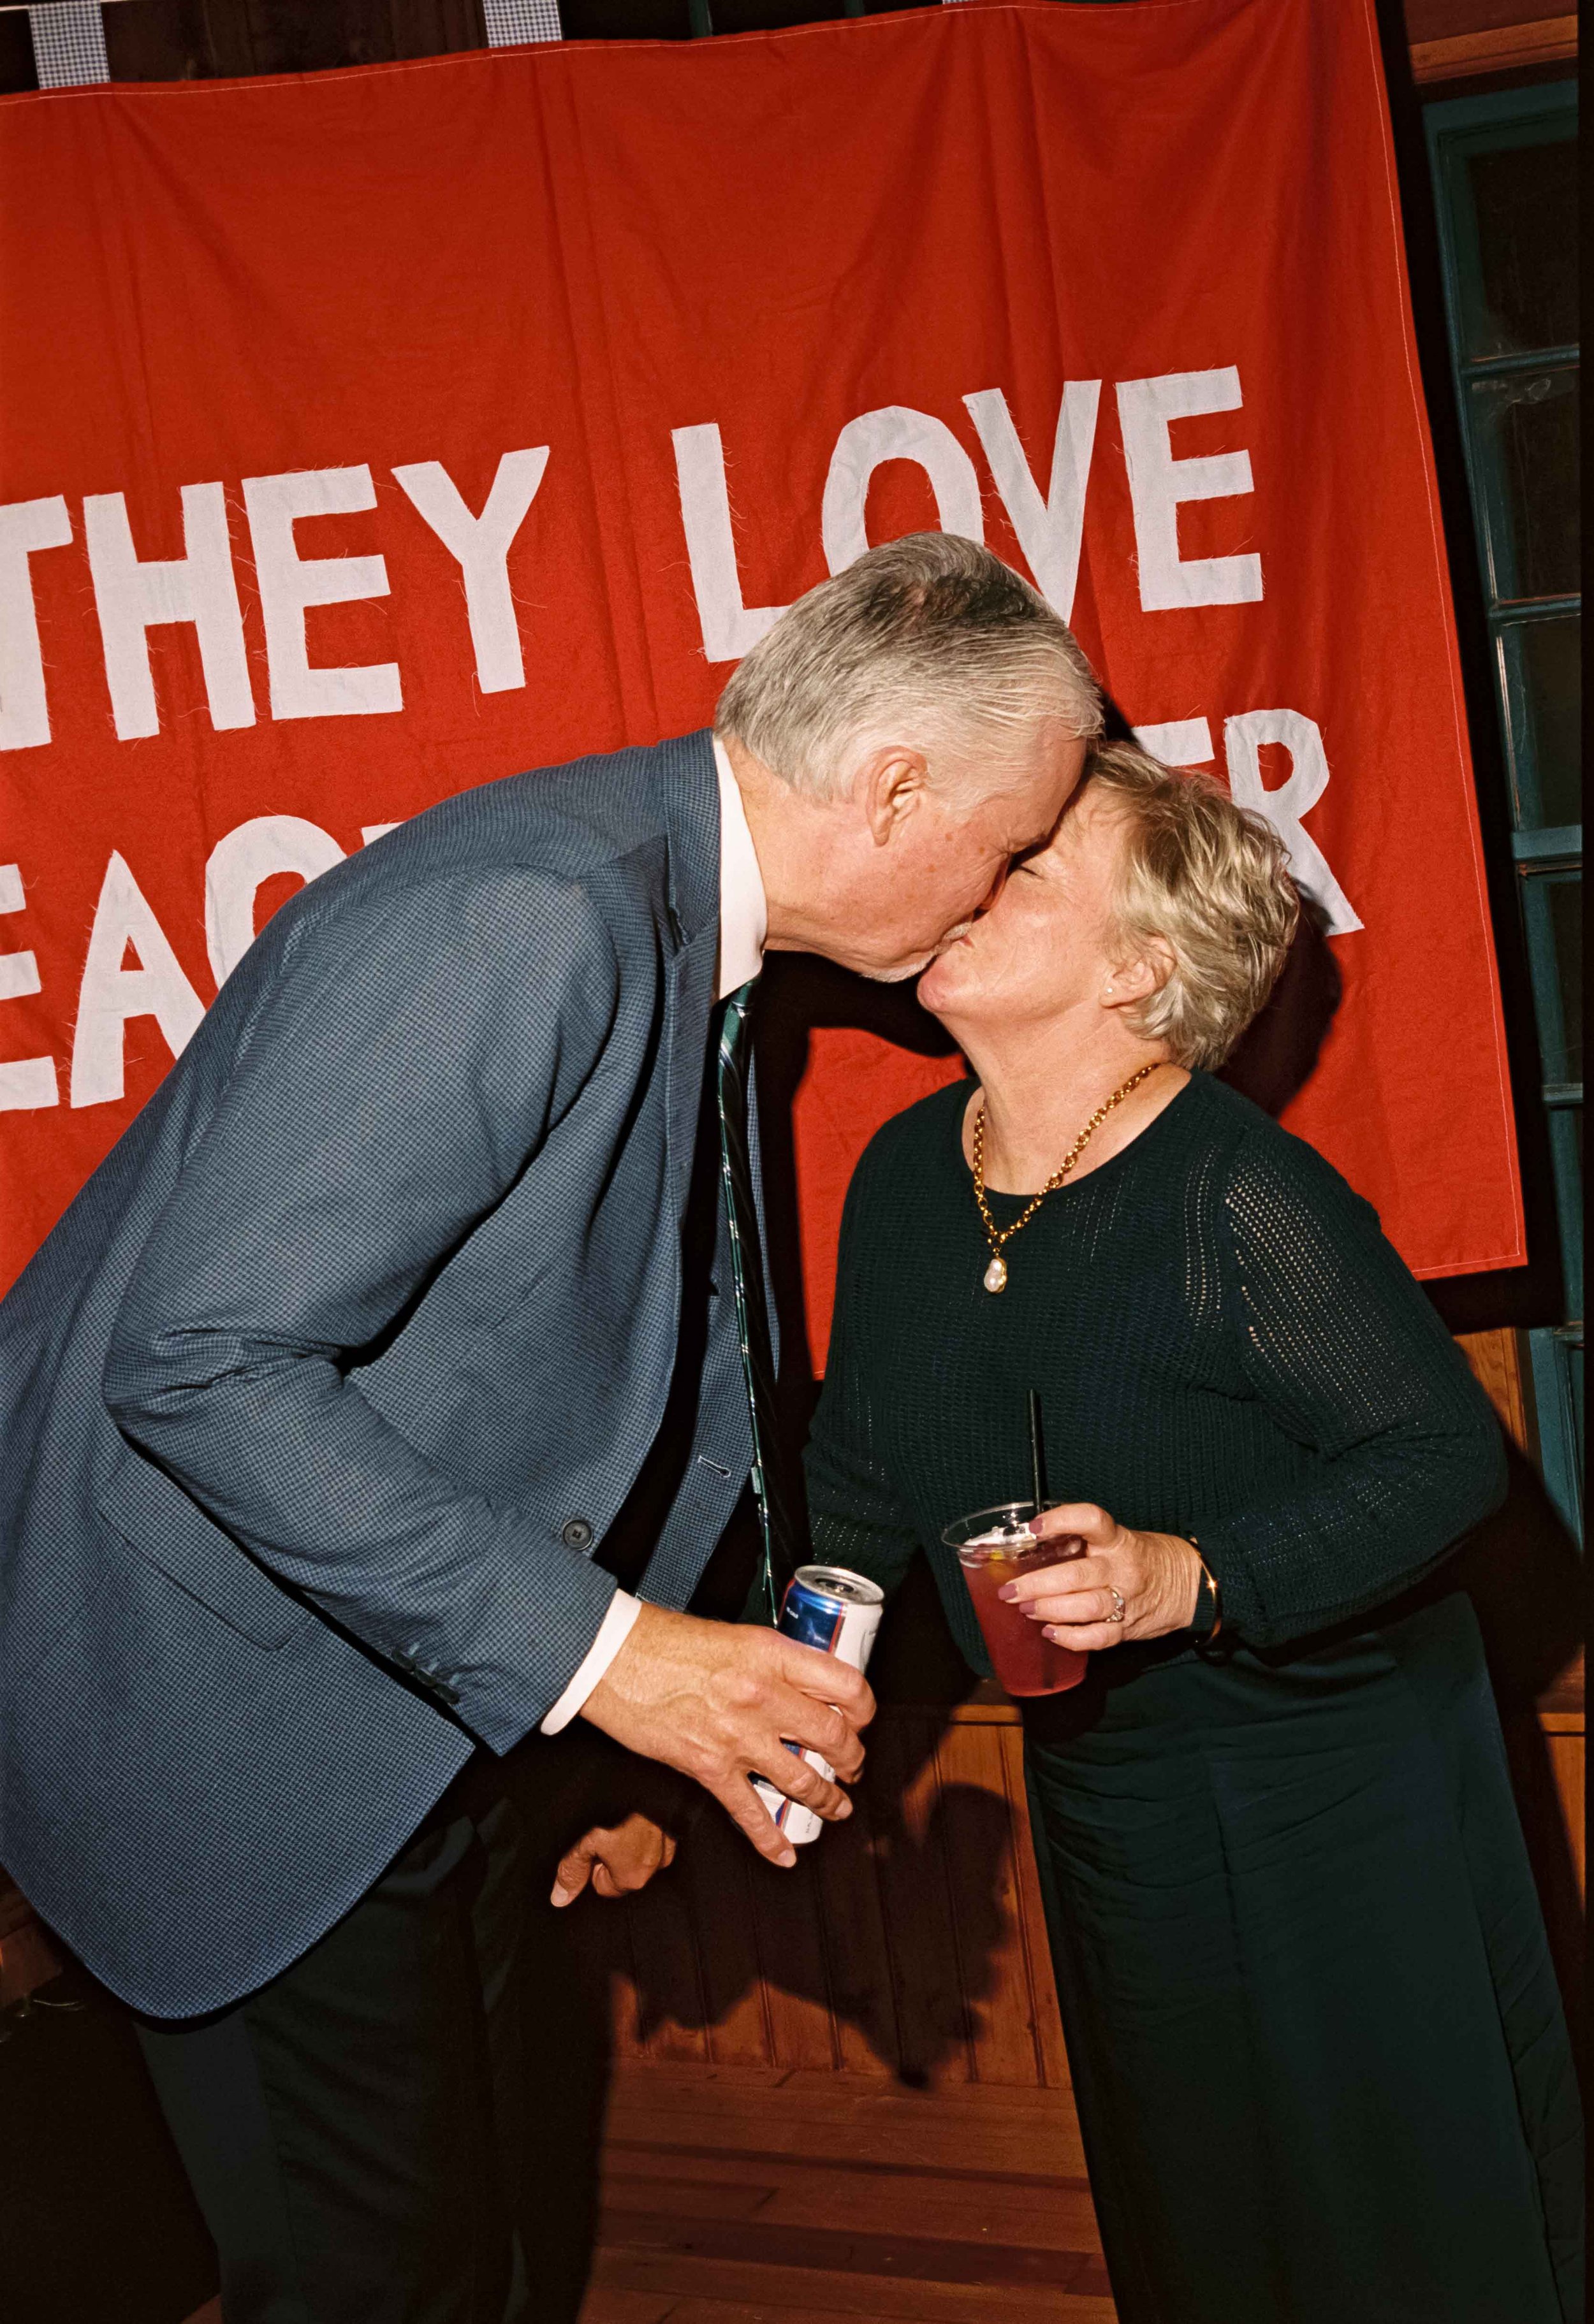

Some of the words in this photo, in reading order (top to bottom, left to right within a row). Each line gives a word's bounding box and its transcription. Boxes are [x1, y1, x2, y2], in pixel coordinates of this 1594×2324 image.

[0, 446, 550, 751] THEY
[671, 365, 1262, 662] LOVE
[0, 815, 405, 1111] AC
